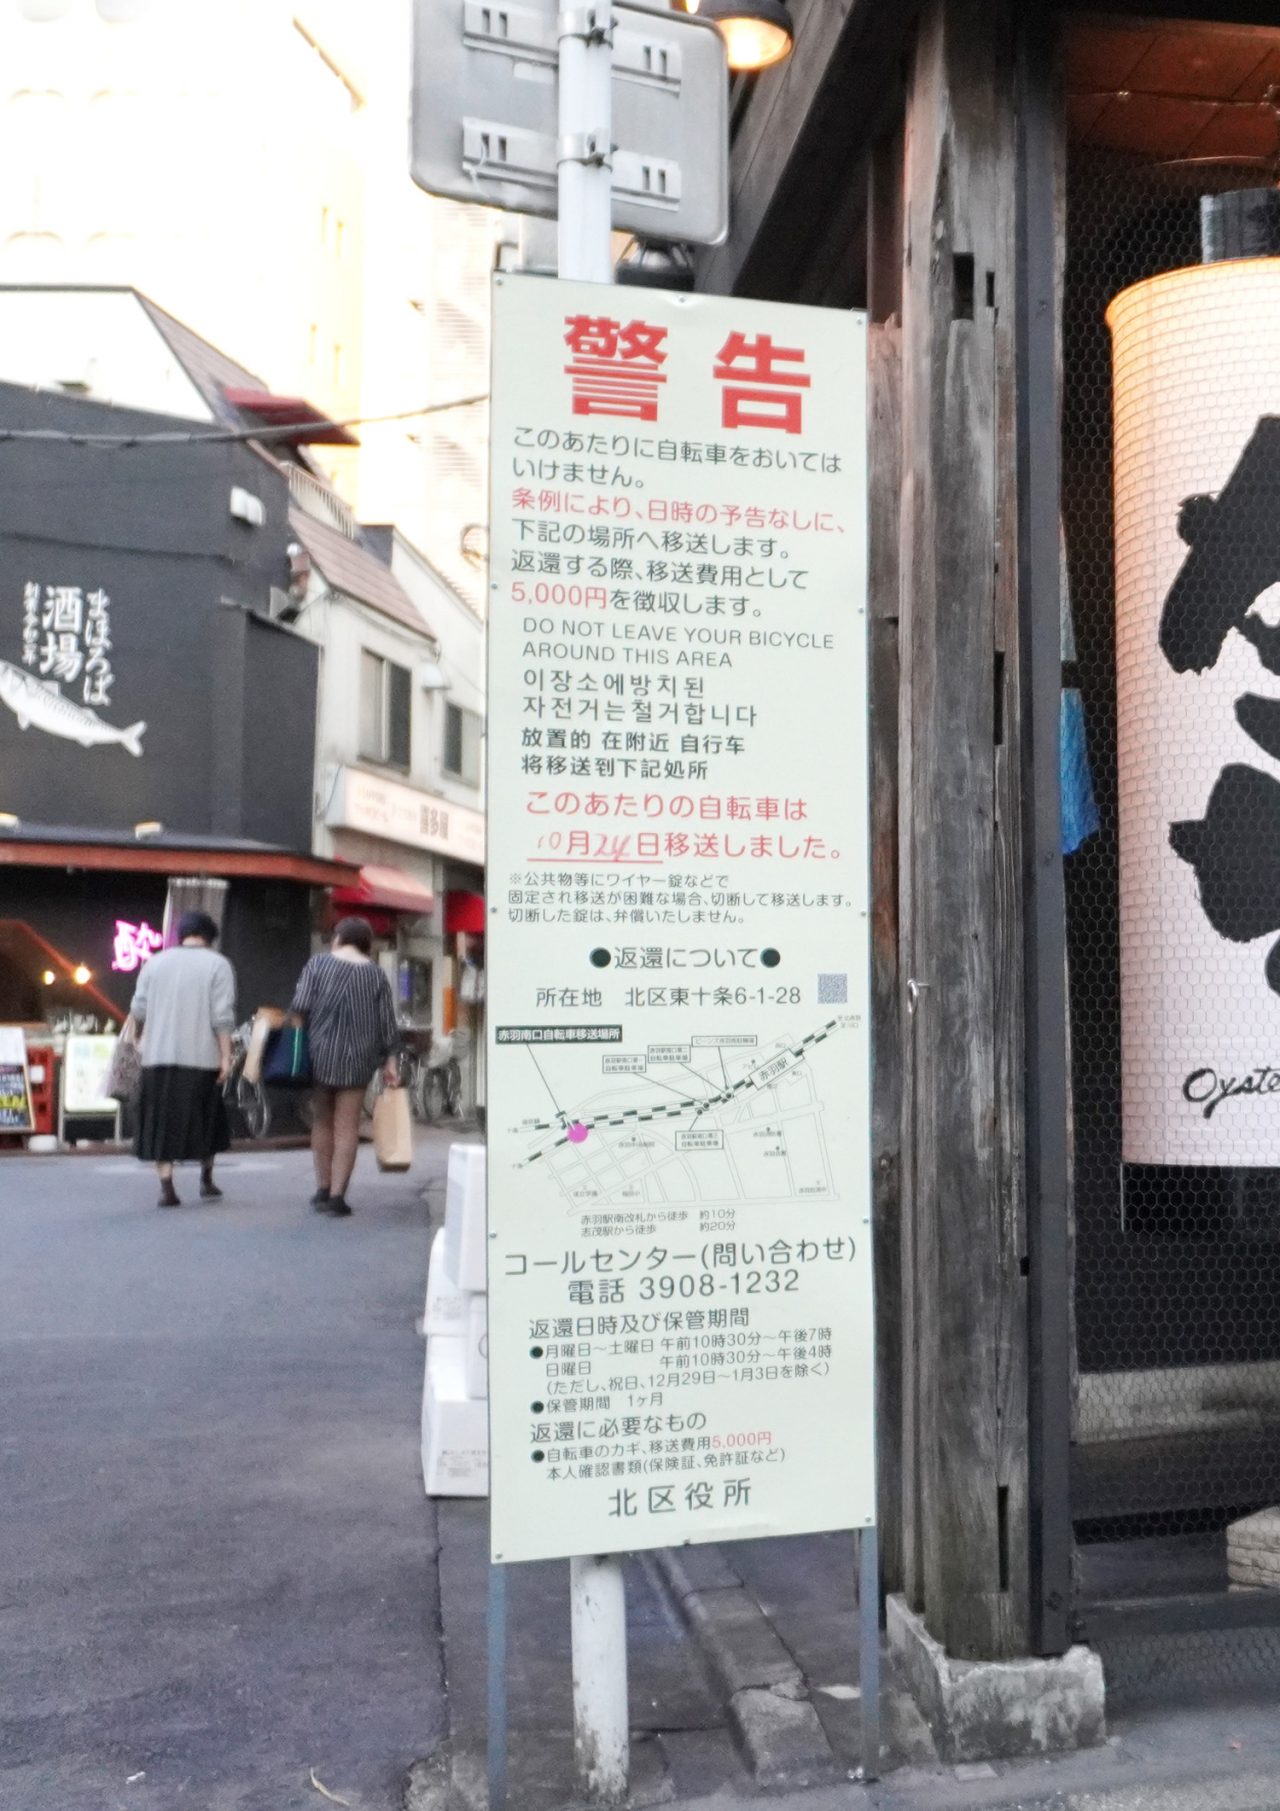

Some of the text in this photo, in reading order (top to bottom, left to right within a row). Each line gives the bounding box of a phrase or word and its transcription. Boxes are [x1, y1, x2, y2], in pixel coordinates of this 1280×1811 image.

[564, 314, 812, 434] 警告
[514, 427, 842, 474] このあたりに自転車をおいては
[512, 456, 645, 489] いけません。
[511, 487, 846, 533] 条例により、日時の予告なしに、
[511, 518, 790, 560] 下記の場所へ移送します。
[510, 549, 809, 590] 返還する際、移送費用として
[40, 585, 83, 683] 酒場
[523, 617, 835, 650] DO NOT LEAVE YOUR BICYCLE
[522, 642, 732, 668] AROUND THIS AREA
[521, 727, 746, 755] 放置的 在附近 自行车
[526, 791, 808, 822] このあたりの自転車は
[508, 890, 852, 909] 固定され移送が困難な場合、切断して移送します。
[508, 908, 746, 925] 切断した錠は、弁償いたしません。
[535, 986, 802, 1009] 所在地 北区東十条6-1-28
[759, 1057, 789, 1081] 赤羽駅
[699, 1208, 736, 1221] 約10分
[699, 1220, 736, 1232] 約20分
[568, 1269, 800, 1306] 電話 3908-1232
[529, 1307, 750, 1340] 返還日時及び保管期間
[546, 1361, 592, 1377] 日曜日
[546, 1395, 610, 1414] 保管期間
[530, 1412, 707, 1443] 返還に必要なもの
[608, 1477, 751, 1518] 北区役所
